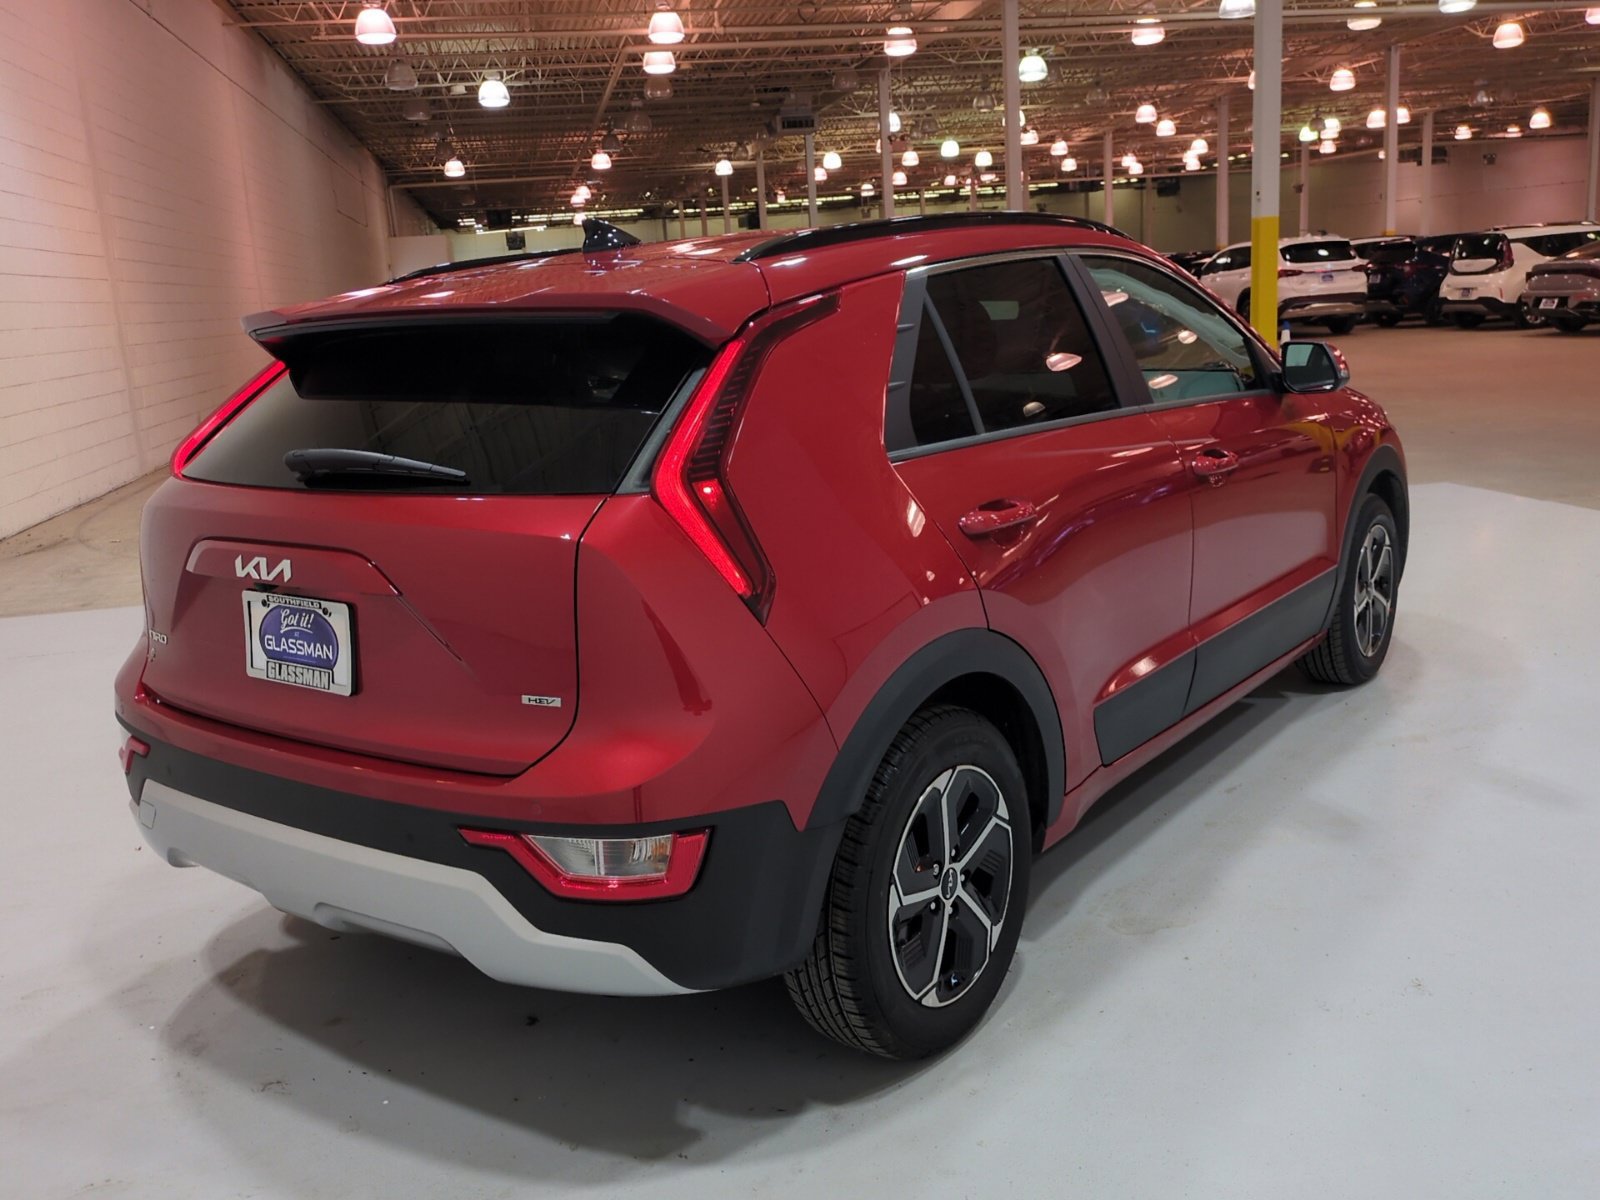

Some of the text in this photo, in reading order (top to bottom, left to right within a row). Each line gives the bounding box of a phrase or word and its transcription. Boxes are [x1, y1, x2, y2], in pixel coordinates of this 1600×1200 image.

[235, 555, 292, 583] KIA
[268, 595, 320, 609] SOUTHFIELD
[280, 608, 315, 631] Got it!
[264, 635, 333, 660] GLASSMAN
[267, 661, 329, 690] GLASSMAN
[528, 697, 556, 705] HEV
